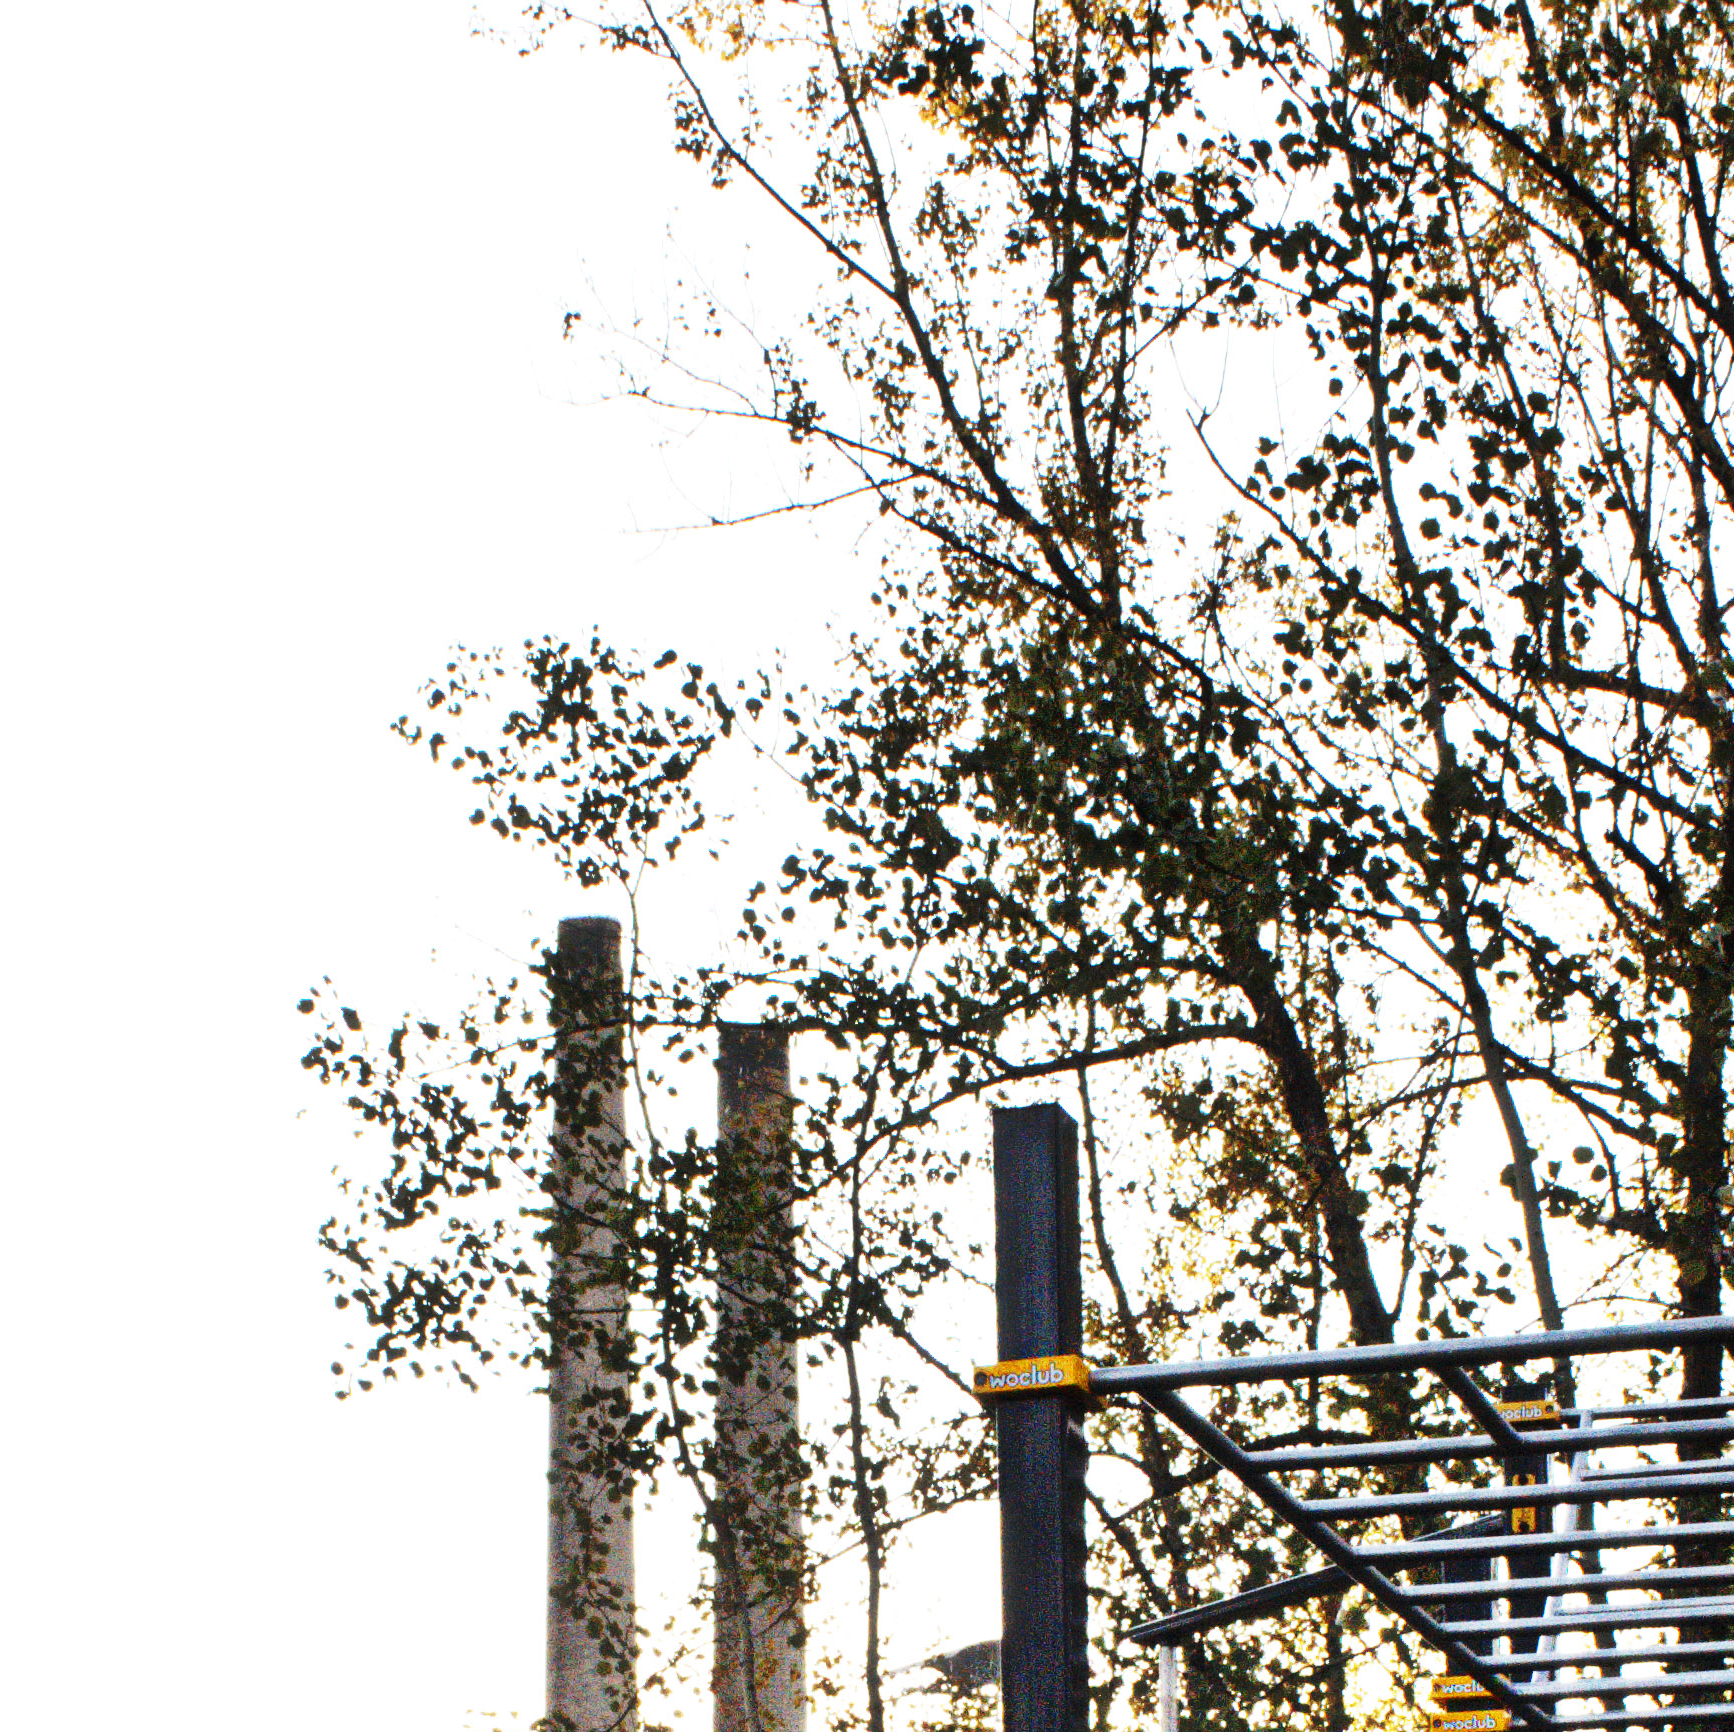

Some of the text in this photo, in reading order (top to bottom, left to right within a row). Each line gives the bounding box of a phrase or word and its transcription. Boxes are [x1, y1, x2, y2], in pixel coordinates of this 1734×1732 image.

[989, 1361, 1064, 1389] woclub
[1441, 1680, 1484, 1693] woclu
[1442, 1714, 1496, 1730] woclub
